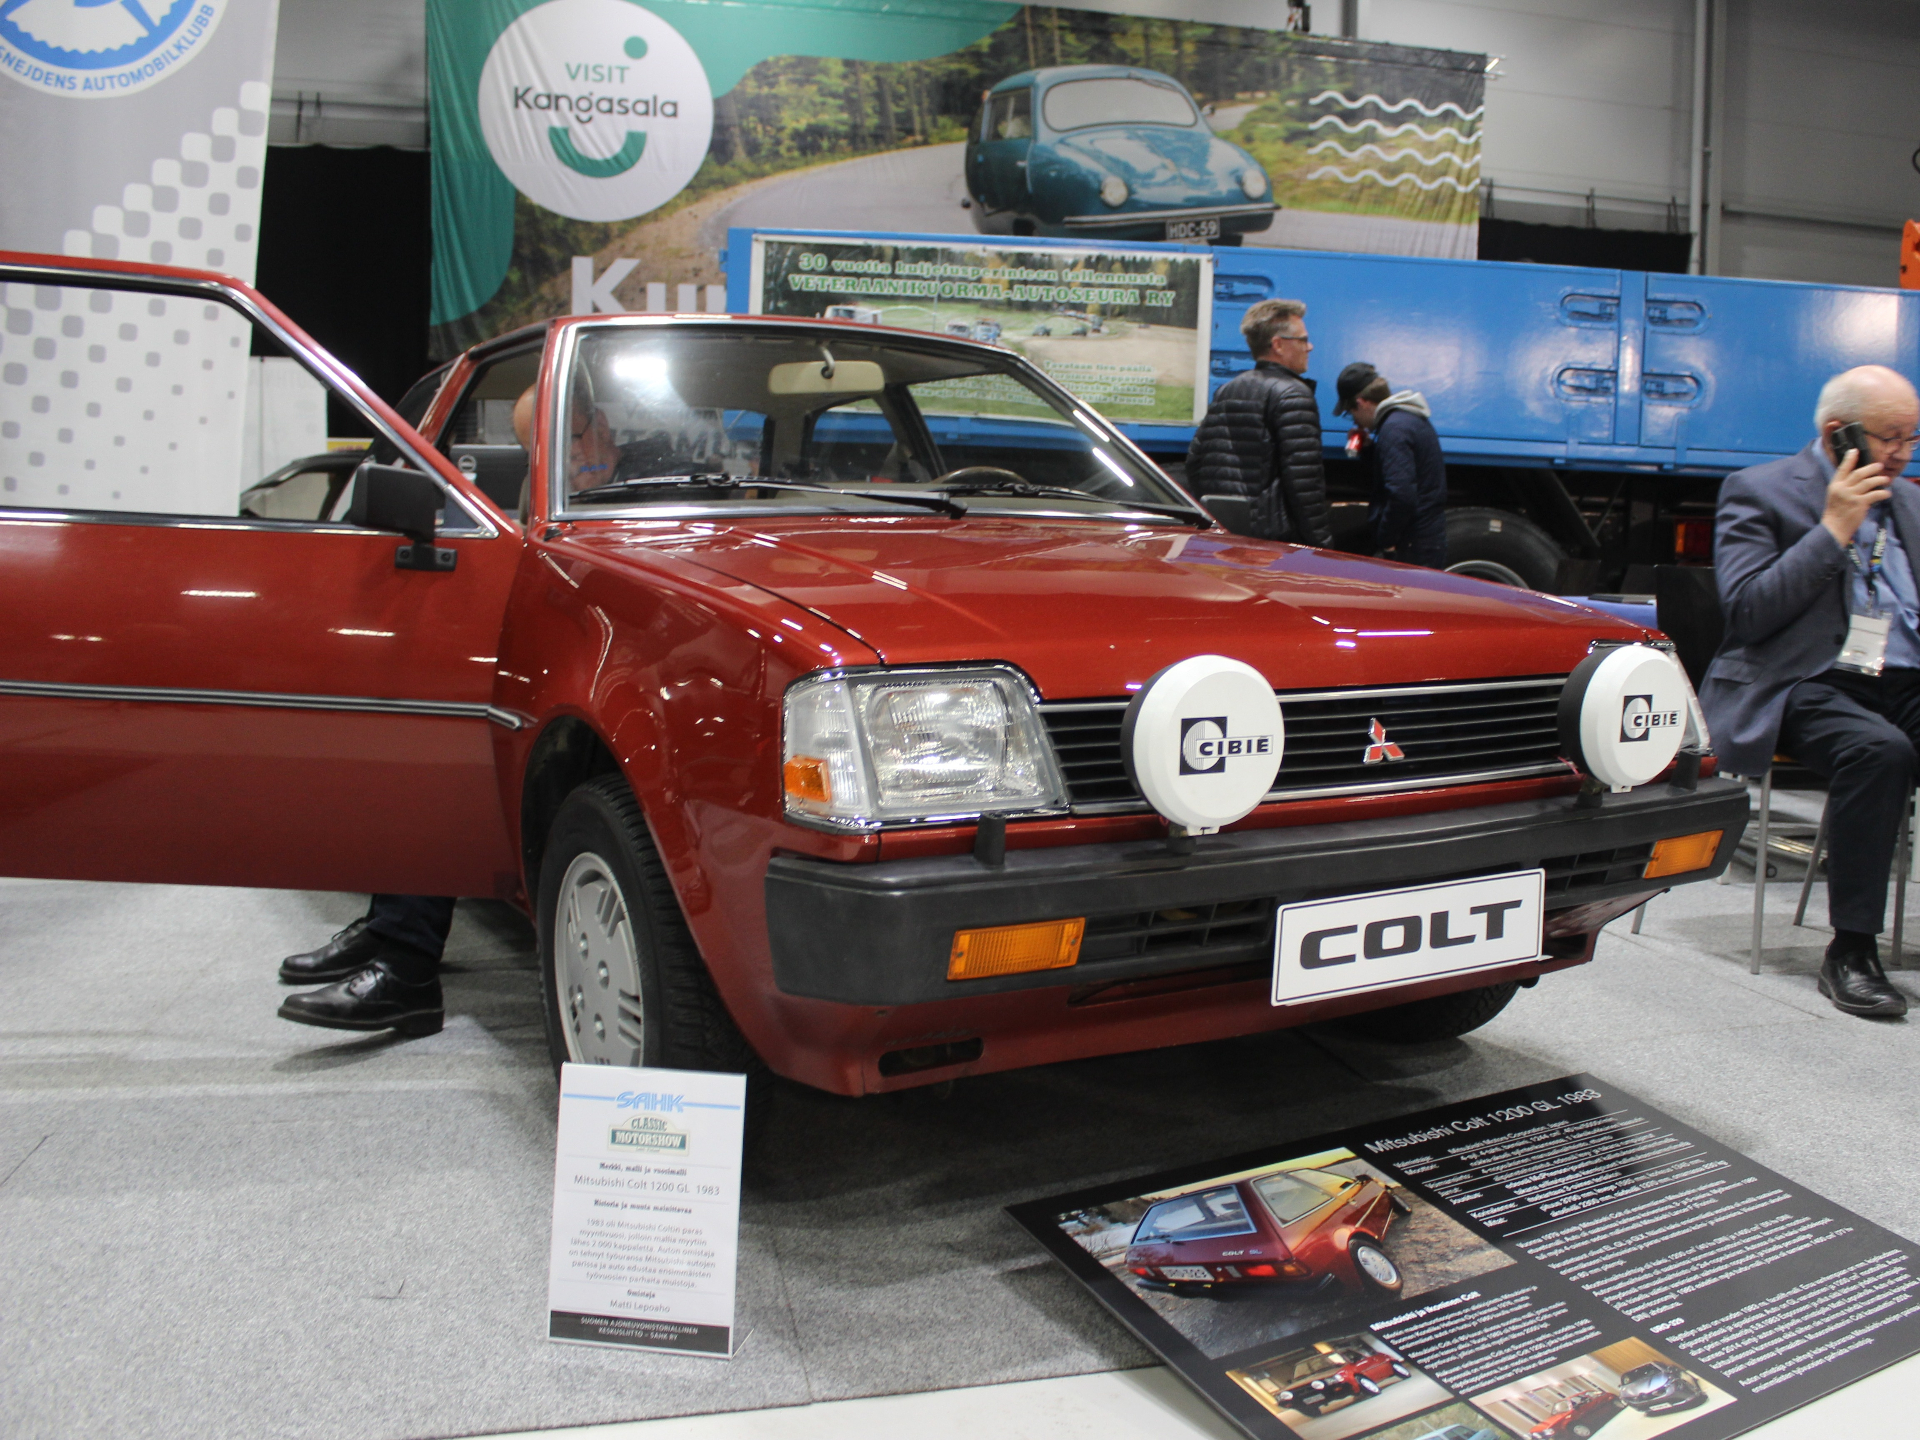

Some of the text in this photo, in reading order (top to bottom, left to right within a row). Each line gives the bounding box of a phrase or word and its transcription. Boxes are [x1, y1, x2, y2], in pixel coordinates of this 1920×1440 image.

[82, 3, 215, 91] AUTOMOBILKLUBB
[565, 62, 630, 83] VISIT
[513, 86, 678, 124] Kangasala
[1169, 220, 1217, 238] HDC-59
[799, 252, 1167, 286] 30 vuotta kuljetusperinteen tallennusta
[788, 274, 1176, 307] VETERAANIKUORMA-AUTOSEURA RY
[1300, 899, 1523, 970] COLT
[616, 1091, 686, 1113] SAHK
[631, 1117, 668, 1132] CLASSIC
[1364, 1088, 1603, 1154] Mitsubishi Colt 1200 GL 1983
[614, 1131, 682, 1148] MOTORSHOW
[574, 1175, 721, 1196] Mitsubishi Colt 1200 GL 1983
[618, 1220, 657, 1232] Mitsubishi
[609, 1299, 671, 1314] Matti Lepoaho
[580, 1316, 609, 1327] SUOMEN
